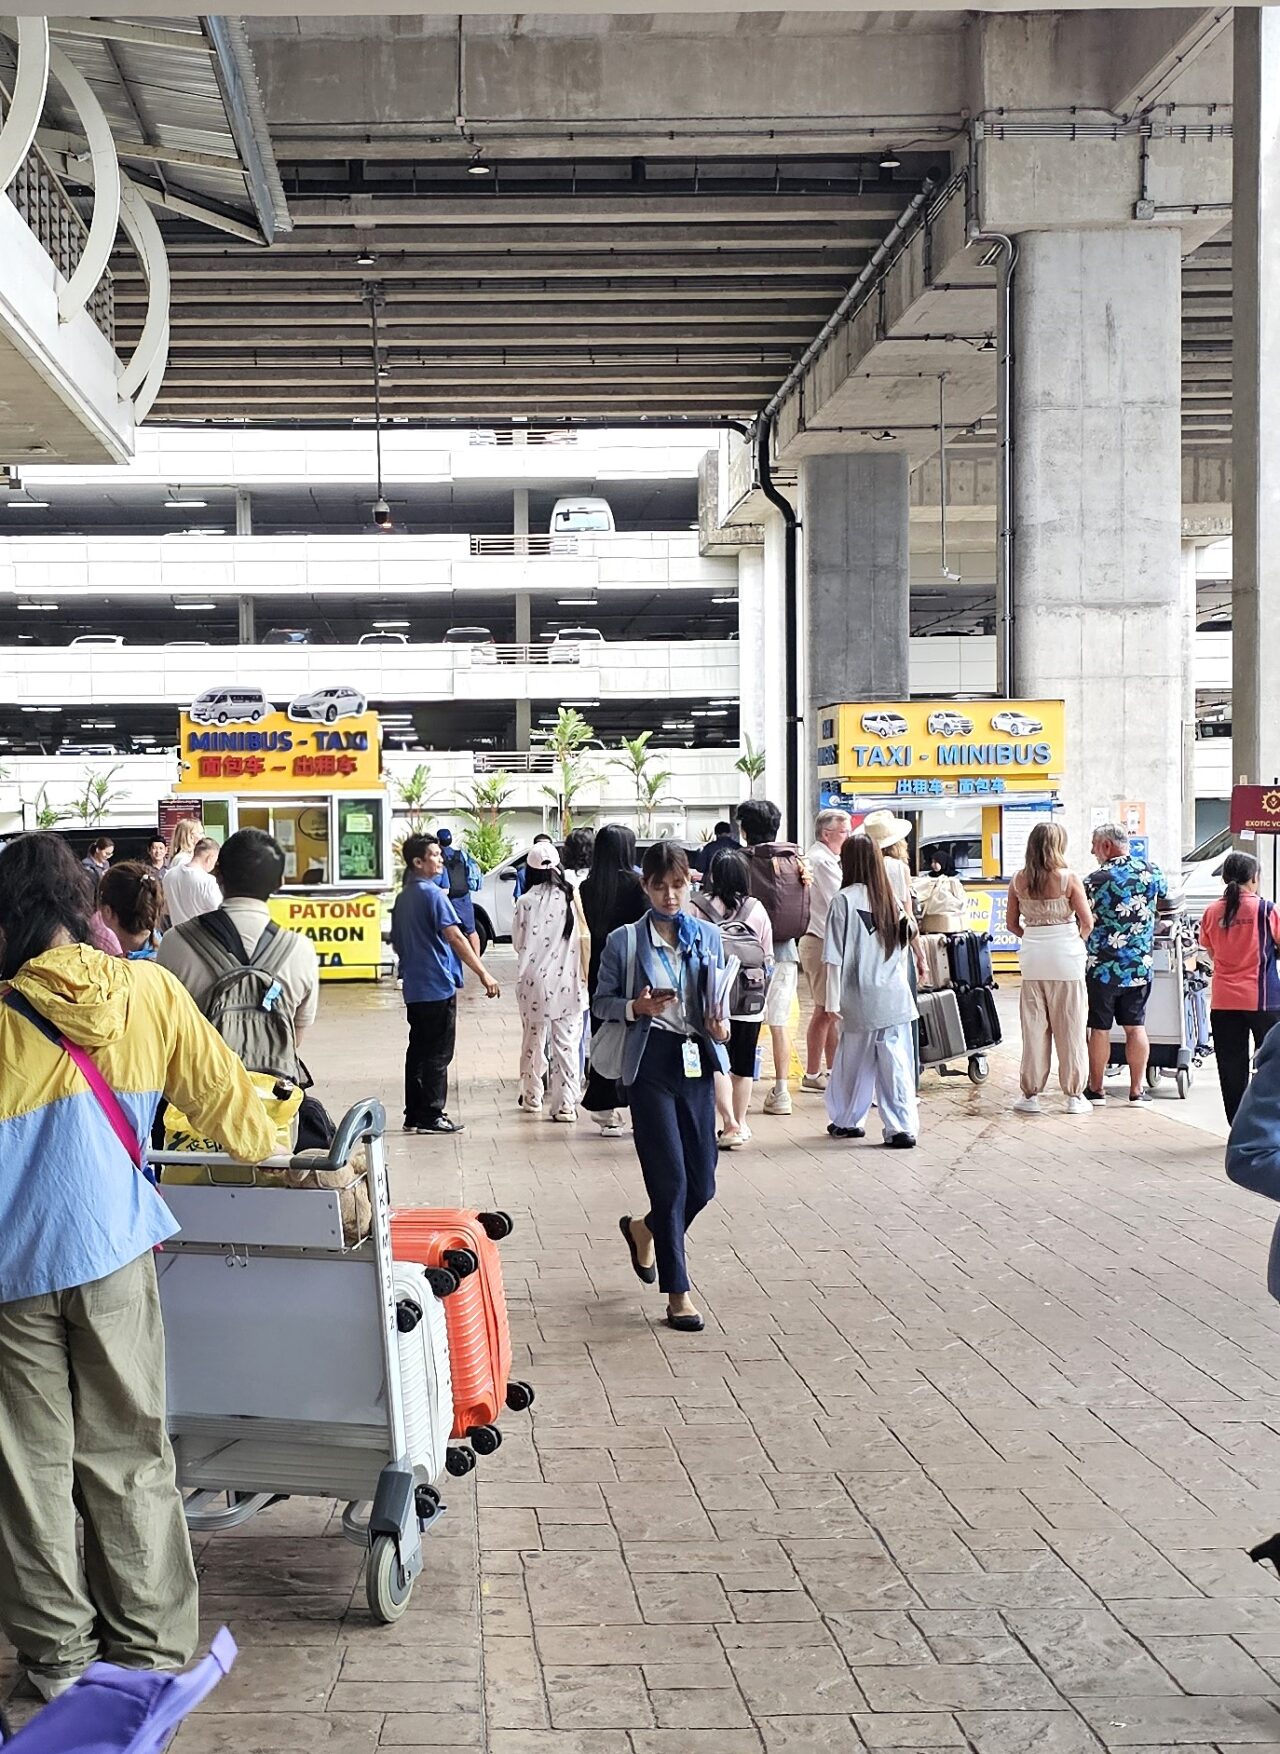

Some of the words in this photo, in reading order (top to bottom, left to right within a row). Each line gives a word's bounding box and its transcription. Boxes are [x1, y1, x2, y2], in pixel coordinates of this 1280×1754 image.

[188, 731, 293, 752] MINIBUS
[312, 730, 368, 751] TAXI
[852, 745, 912, 767] TAXI
[937, 743, 1051, 765] MINIBUS
[199, 755, 266, 777] 面包车
[292, 754, 357, 777] 出租车
[896, 779, 944, 795] 出租车
[956, 777, 1006, 794] 面包车
[289, 903, 376, 919] PATONG
[316, 952, 343, 966] TA
